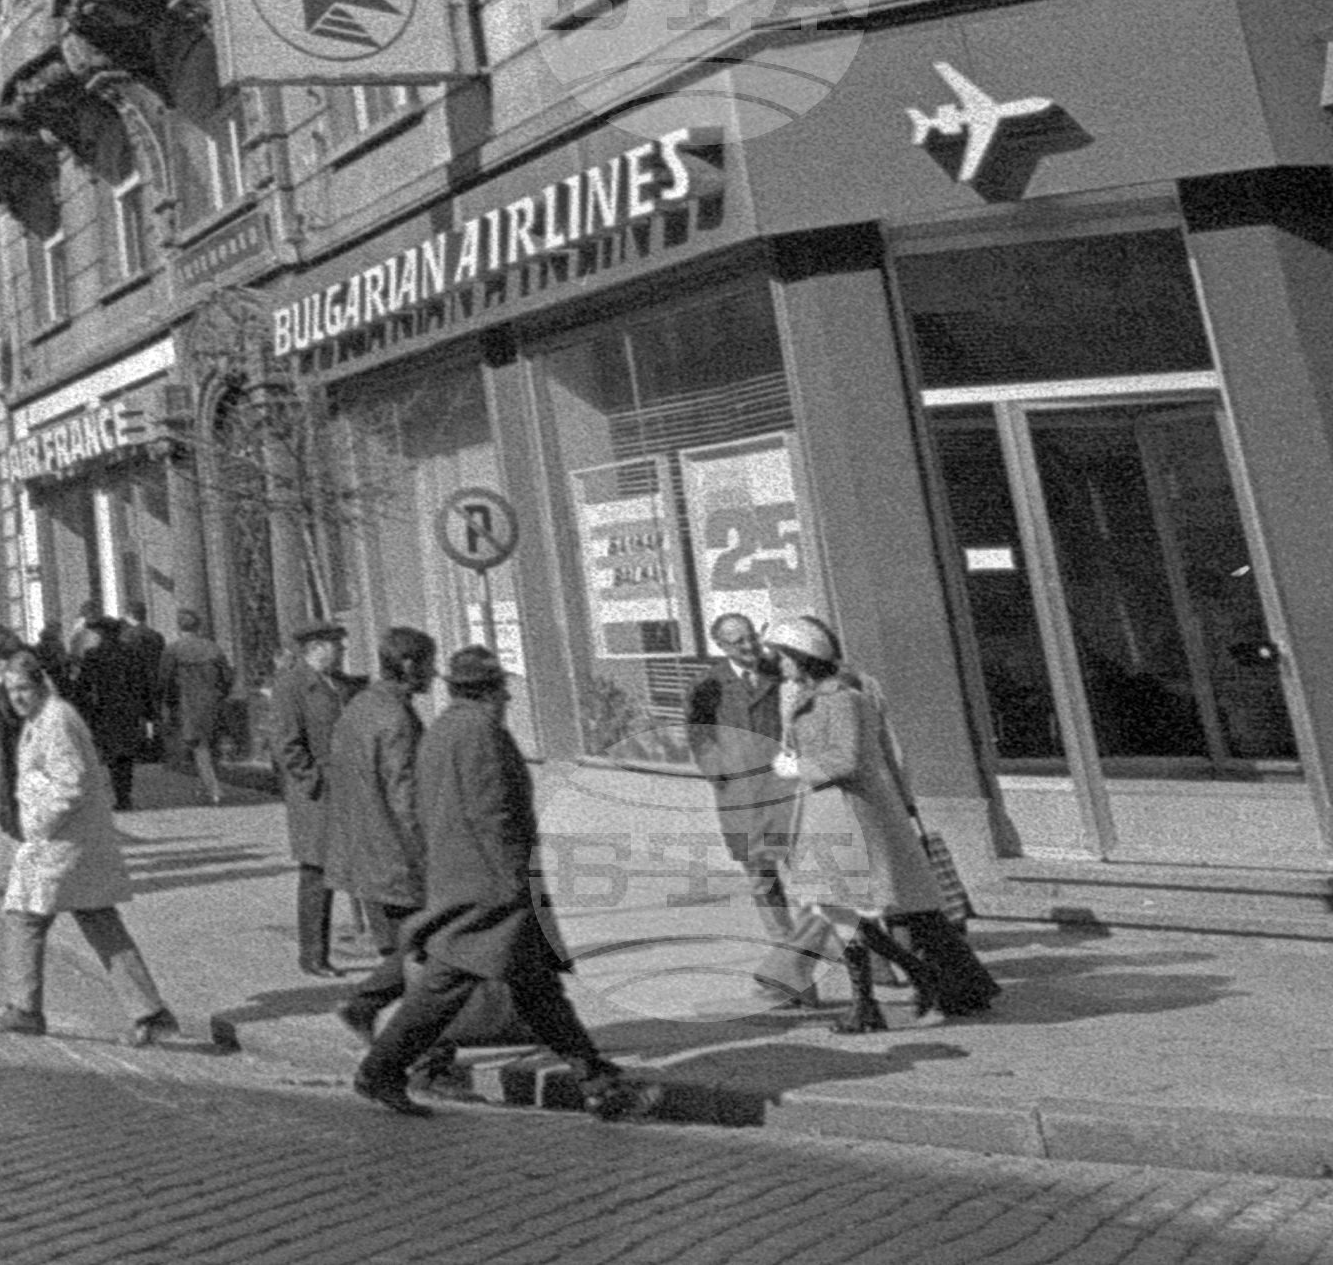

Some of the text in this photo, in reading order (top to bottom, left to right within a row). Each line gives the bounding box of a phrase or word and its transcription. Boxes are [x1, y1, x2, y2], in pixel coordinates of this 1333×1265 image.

[273, 233, 447, 357] BULGARIAN
[454, 128, 690, 282] AIRLINES
[44, 402, 130, 472] FRANCE
